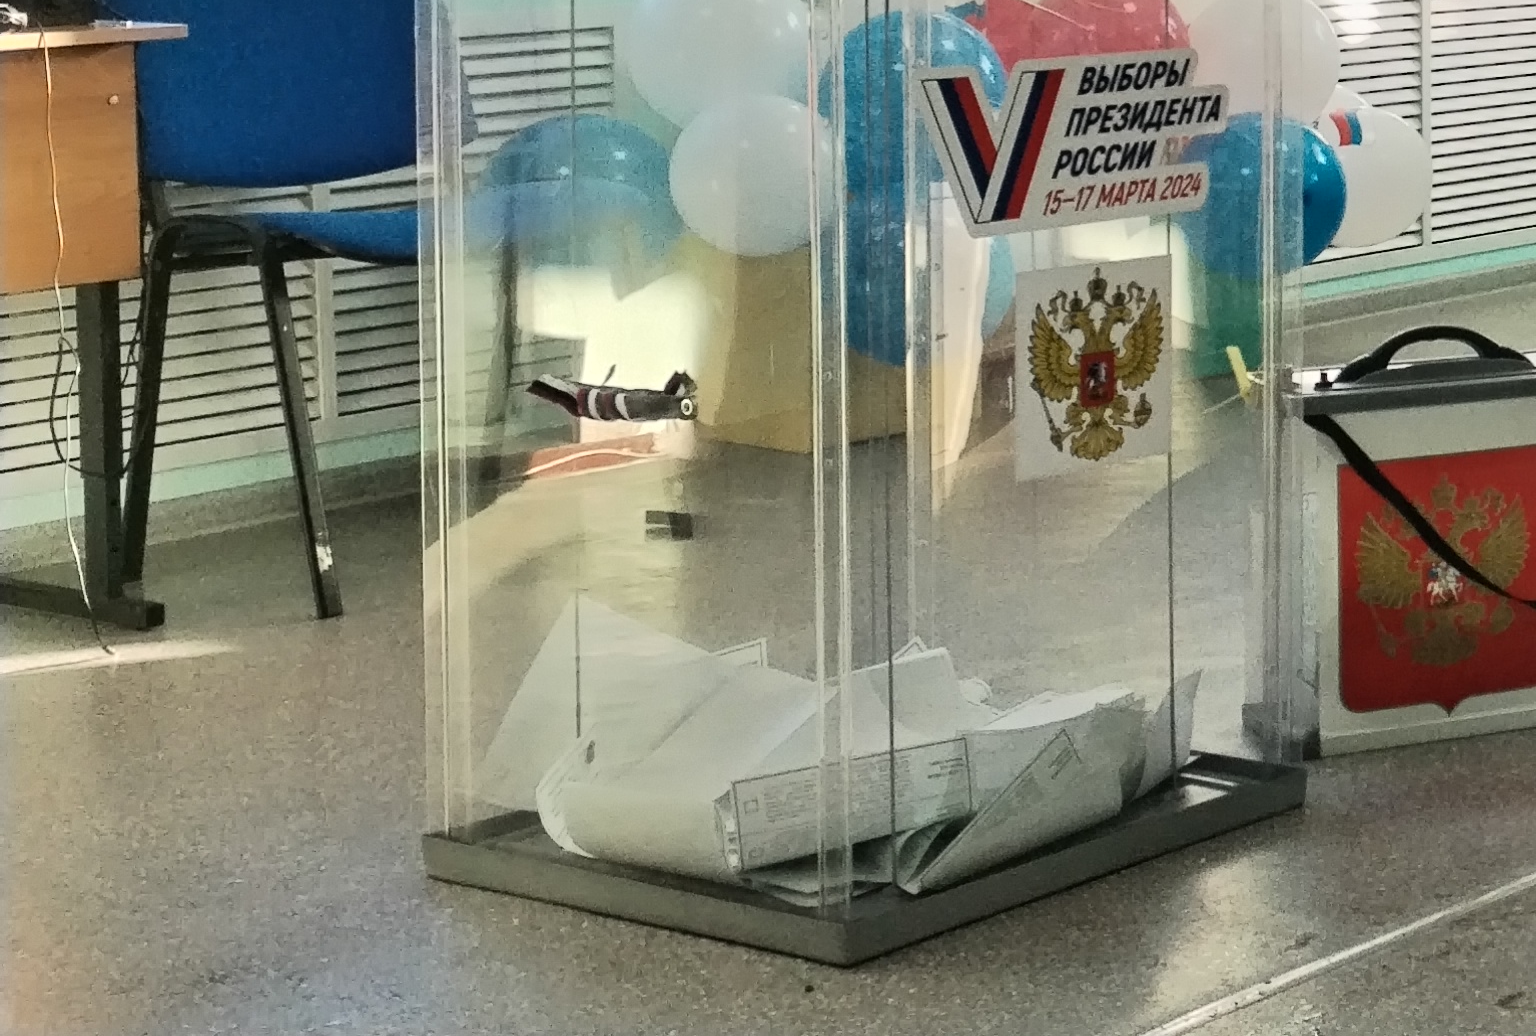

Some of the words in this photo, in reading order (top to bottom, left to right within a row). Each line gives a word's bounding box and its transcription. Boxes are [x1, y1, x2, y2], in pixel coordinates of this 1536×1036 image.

[1077, 58, 1191, 96] ВЫБОРЫ
[1064, 94, 1222, 137] ПРЕЗИДЕНТА
[1052, 139, 1157, 180] РОССИИ
[1095, 178, 1158, 209] МАРТА
[1159, 172, 1203, 202] 2024
